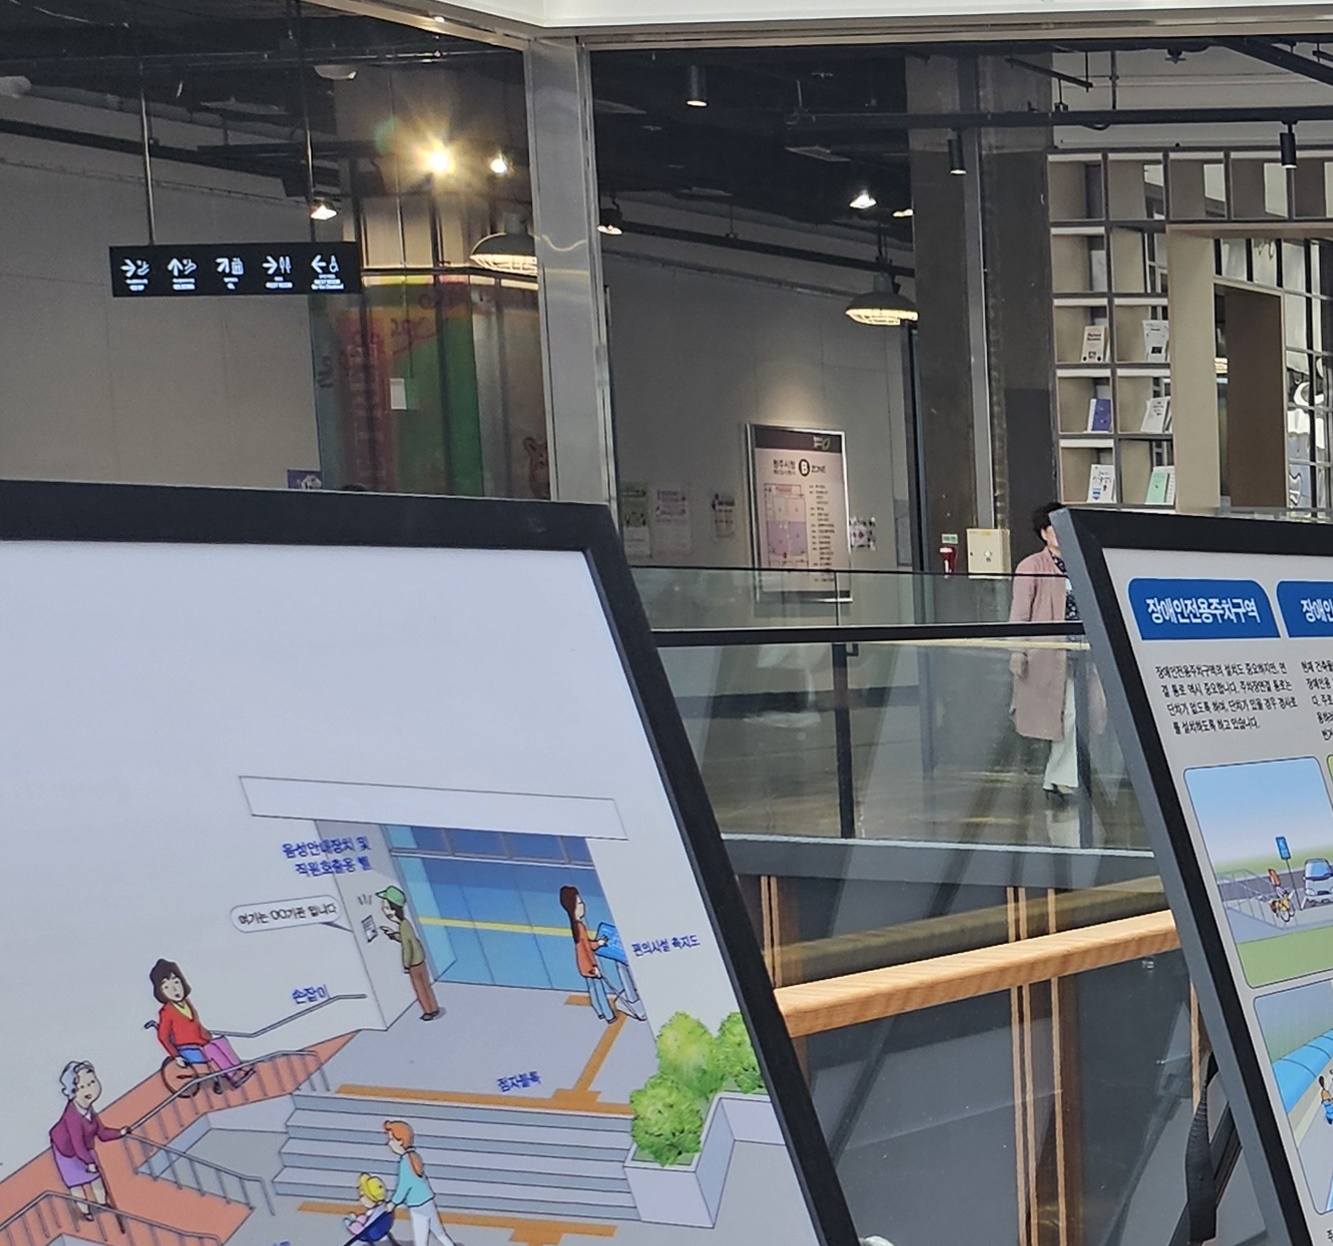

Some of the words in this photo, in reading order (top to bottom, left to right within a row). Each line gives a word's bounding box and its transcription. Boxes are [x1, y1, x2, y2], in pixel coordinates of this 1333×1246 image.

[1145, 596, 1262, 625] 장애인전용주차구역
[282, 837, 355, 858] 음성안내장치
[631, 939, 670, 957] 편의시설
[292, 984, 330, 1004] 손잡이
[497, 1071, 542, 1093] 점자블록
